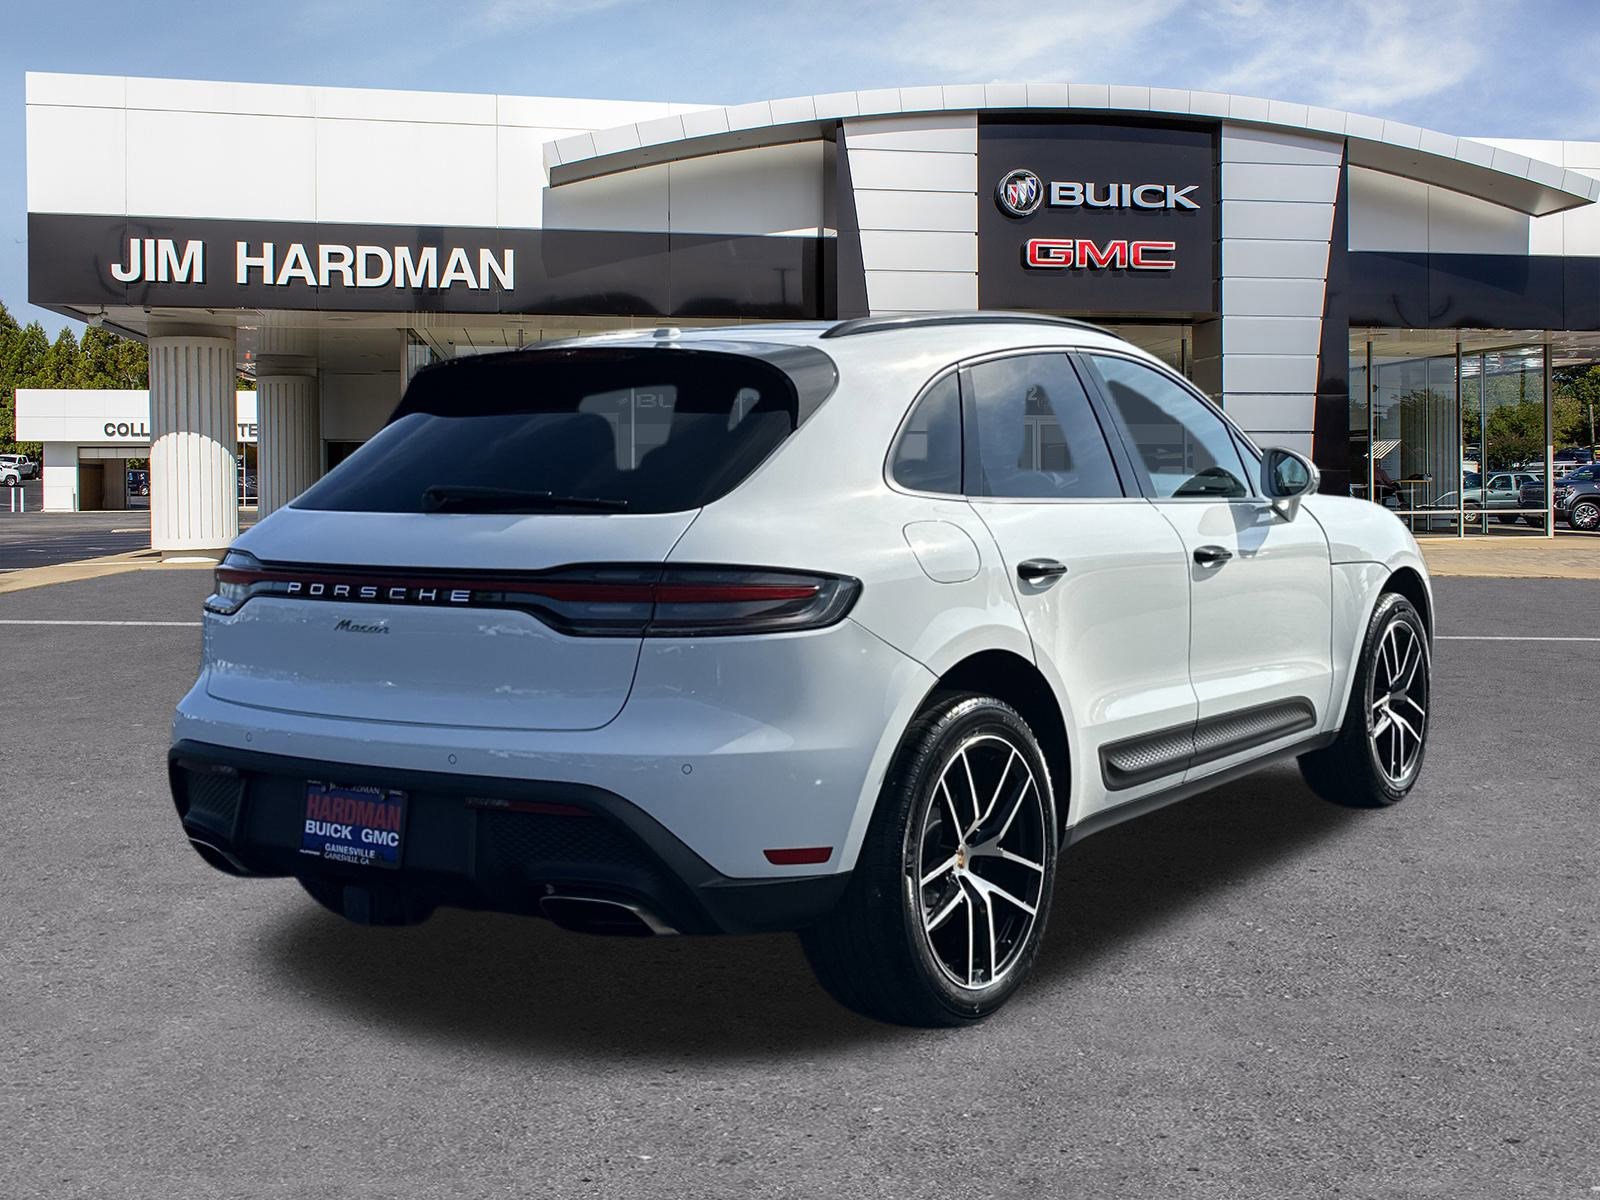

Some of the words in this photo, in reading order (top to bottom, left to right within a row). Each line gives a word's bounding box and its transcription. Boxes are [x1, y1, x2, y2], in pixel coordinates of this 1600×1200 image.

[1050, 181, 1200, 209] BUICK
[111, 238, 203, 284] JIM
[236, 241, 515, 290] HARDMAN
[1026, 238, 1176, 270] GMC
[287, 581, 471, 602] PORSCHE
[334, 619, 391, 635] Macan
[306, 793, 401, 832] HARDMAN
[305, 819, 353, 840] BUICK
[361, 828, 400, 847] GMC
[324, 842, 376, 859] GAINESVILLE
